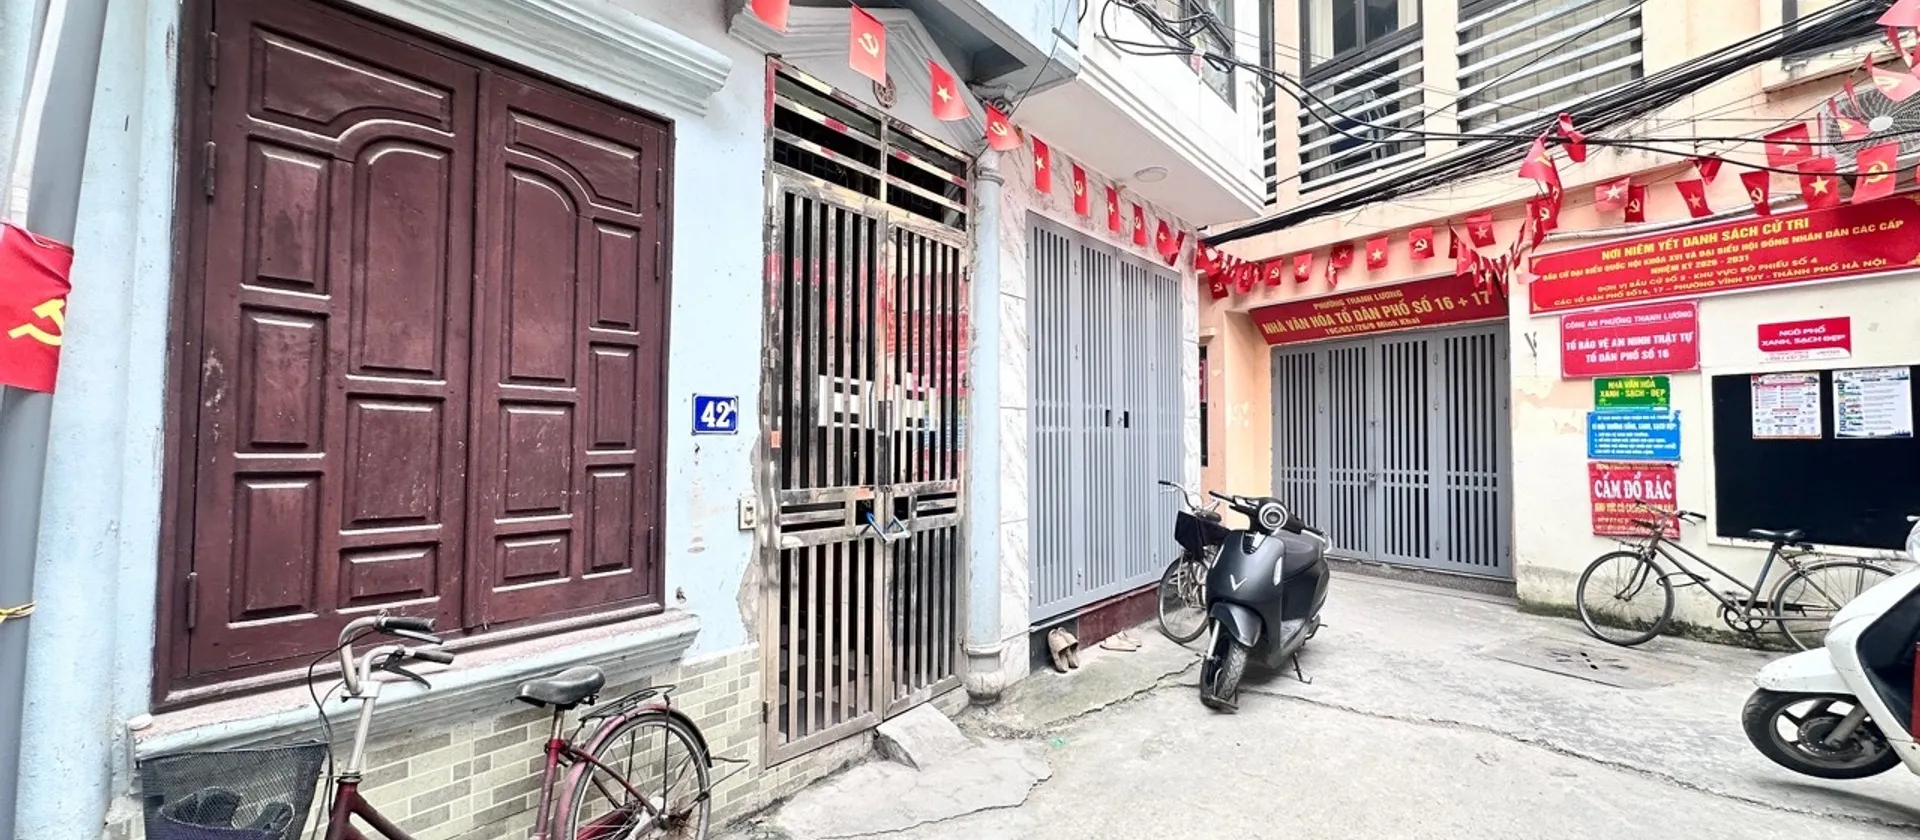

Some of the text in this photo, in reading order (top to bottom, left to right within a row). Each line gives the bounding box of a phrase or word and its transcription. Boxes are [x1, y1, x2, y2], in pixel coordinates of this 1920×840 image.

[1602, 217, 1809, 260] NƠI NIÊM YẾT DANH SÁCH CỬ TRI
[1604, 262, 1626, 272] QUỐC
[1628, 260, 1641, 269] HỘI
[1685, 251, 1697, 259] VÀ
[1717, 244, 1739, 254] BIỂU
[1741, 242, 1758, 251] HỘI
[1761, 235, 1789, 248] ĐỒNG
[1792, 232, 1822, 243] NHÂN
[1825, 228, 1849, 239] DÂN
[1852, 223, 1876, 234] CÁC
[1879, 218, 1904, 231] CẤP
[1597, 284, 1616, 292] ĐƠN
[1629, 278, 1647, 288] BẦU
[1649, 277, 1663, 285] CỬ
[1665, 275, 1677, 283] SỐ
[1693, 271, 1713, 279] KHU
[1716, 268, 1738, 276] VỰC
[1740, 265, 1756, 273] BỎ
[1758, 260, 1788, 270] PHIẾU
[1791, 256, 1808, 266] SỐ
[1650, 264, 1679, 274] NHIỆM
[1681, 262, 1693, 270] KỲ
[1727, 255, 1749, 264] 2031
[1554, 296, 1572, 306] CÁC
[1574, 295, 1584, 304] TỔ
[1586, 293, 1604, 301] DÂN
[1605, 290, 1624, 299] PHỐ
[1674, 280, 1715, 290] PHƯỜNG
[1718, 276, 1742, 285] VĨNH
[1745, 274, 1764, 282] TUY
[1772, 268, 1810, 278] THÀNH
[1813, 262, 1839, 273] PHỐ
[1842, 260, 1859, 270] HÀ
[1863, 258, 1887, 267] NỘI
[1312, 299, 1345, 310] PHƯỜNG
[1346, 294, 1374, 305] THANH
[1262, 291, 1490, 334] NHÀ VĂN HÓA TỔ DÂN PHỐ SỐ 16 + 17
[1565, 321, 1585, 329] CÔNG
[1600, 316, 1632, 327] PHƯỜNG
[1634, 314, 1662, 323] THANH
[1663, 310, 1693, 320] LƯƠNG
[1803, 324, 1826, 334] PHỐ
[1565, 331, 1693, 351] TỔ BẢO VỆ AN NINH TRẬT TỰ
[1586, 347, 1669, 363] TỔ DÂN PHỐ SỐ 16
[1600, 390, 1620, 398] XANH
[1625, 389, 1645, 398] SẠCH
[1650, 389, 1666, 397] ĐẸP
[1608, 379, 1656, 389] NHÀ VĂN HÓA
[1594, 471, 1672, 500] CẤM ĐỔ RÁC
